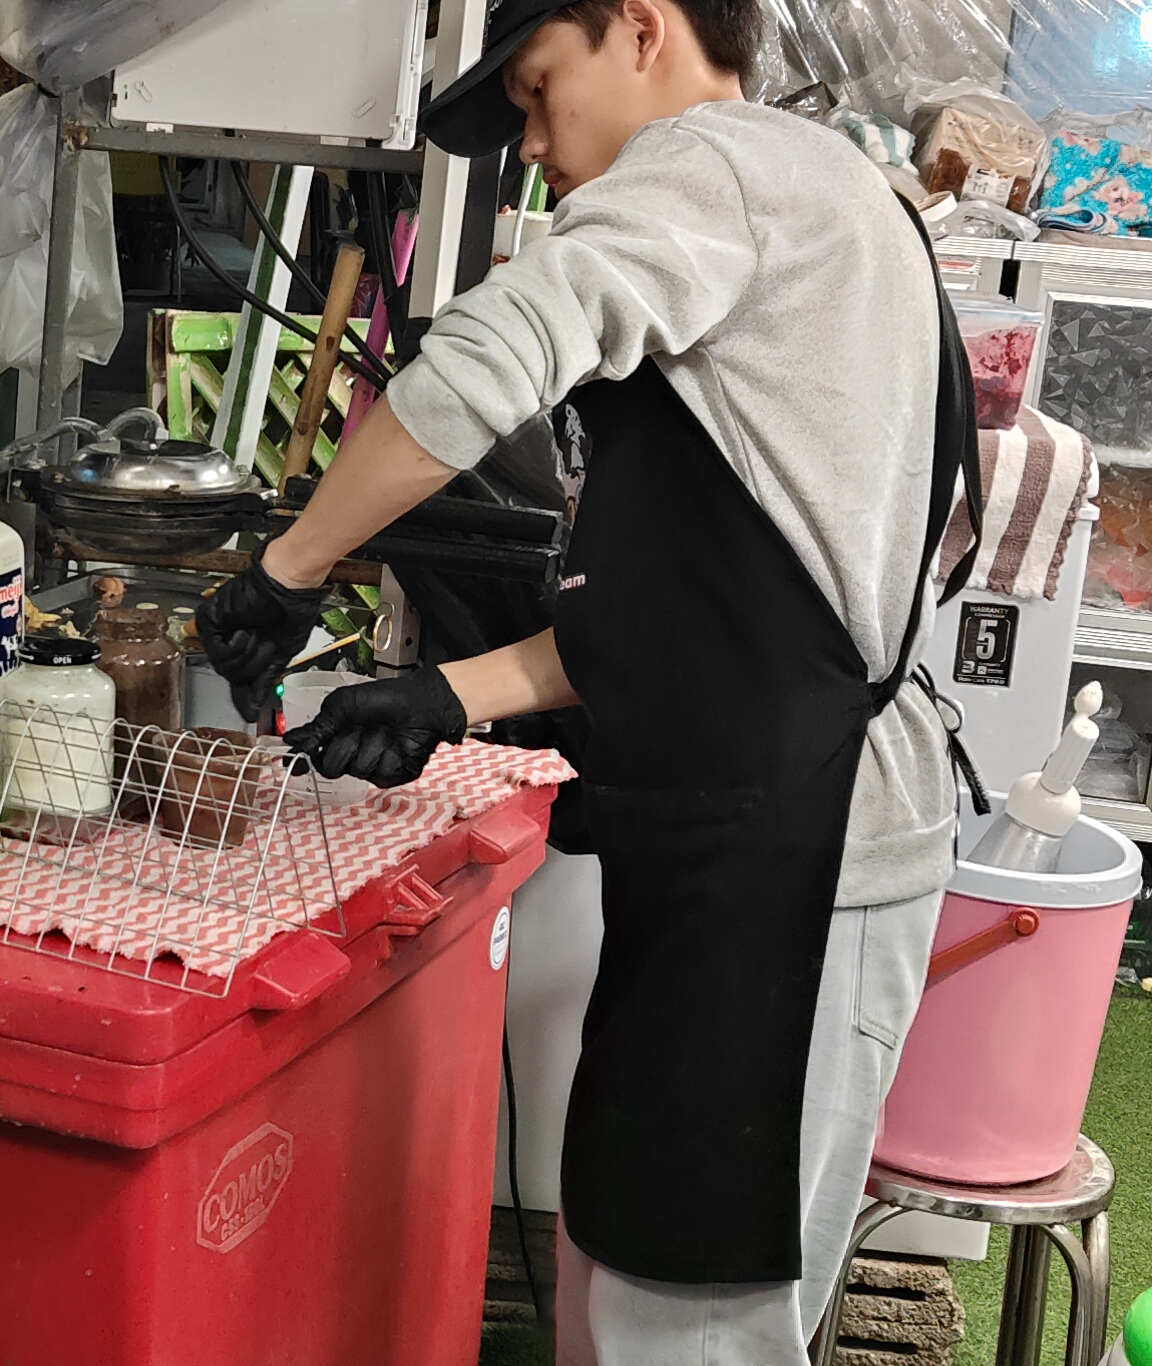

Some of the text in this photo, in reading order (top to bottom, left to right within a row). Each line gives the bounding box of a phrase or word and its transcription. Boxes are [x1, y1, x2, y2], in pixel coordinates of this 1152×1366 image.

[970, 606, 1009, 614] WARRANTY
[976, 619, 998, 659] 5
[53, 656, 72, 664] OPEN
[204, 1143, 287, 1233] COMOS
